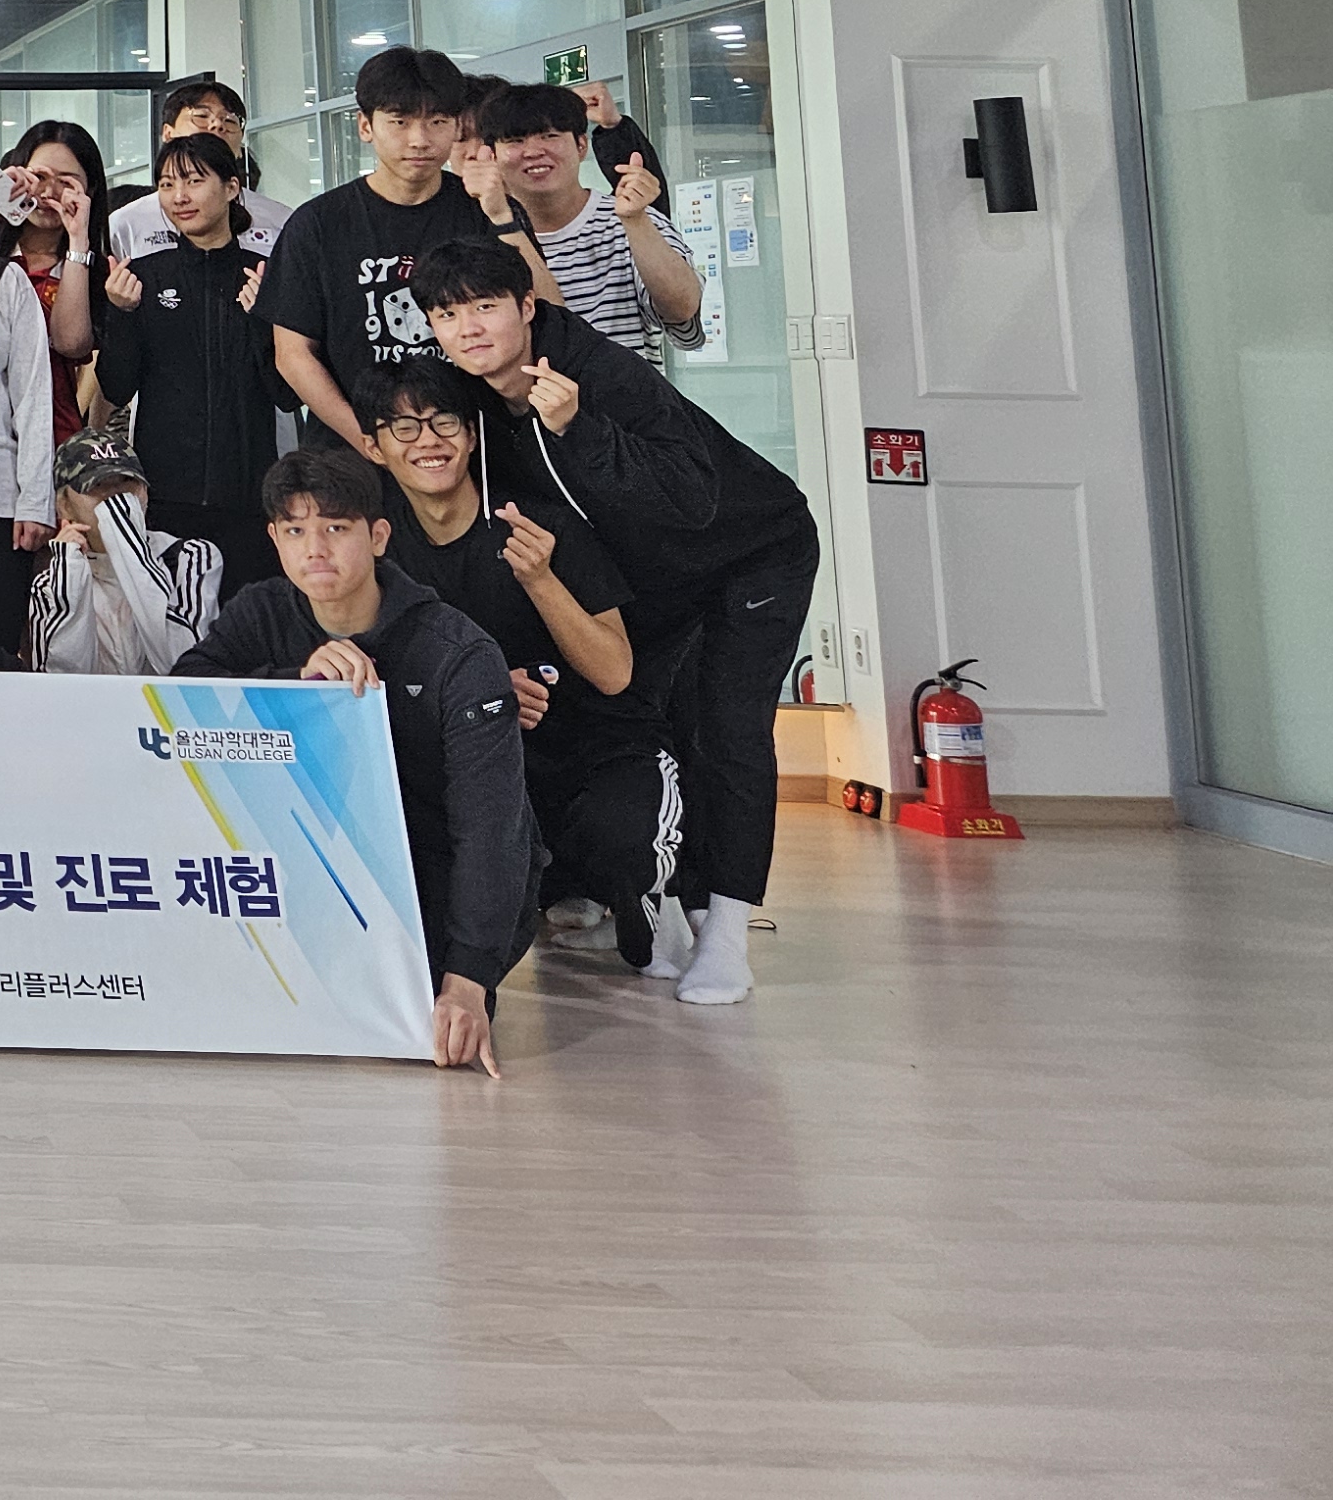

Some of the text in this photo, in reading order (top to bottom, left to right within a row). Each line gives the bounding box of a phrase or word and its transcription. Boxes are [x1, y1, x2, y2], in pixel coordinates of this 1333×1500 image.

[872, 434, 920, 446] 소화기
[175, 729, 293, 749] 울산과학대학교
[177, 747, 294, 762] ULSAN COLLEGE
[54, 853, 161, 914] 진로
[175, 854, 282, 919] 체험
